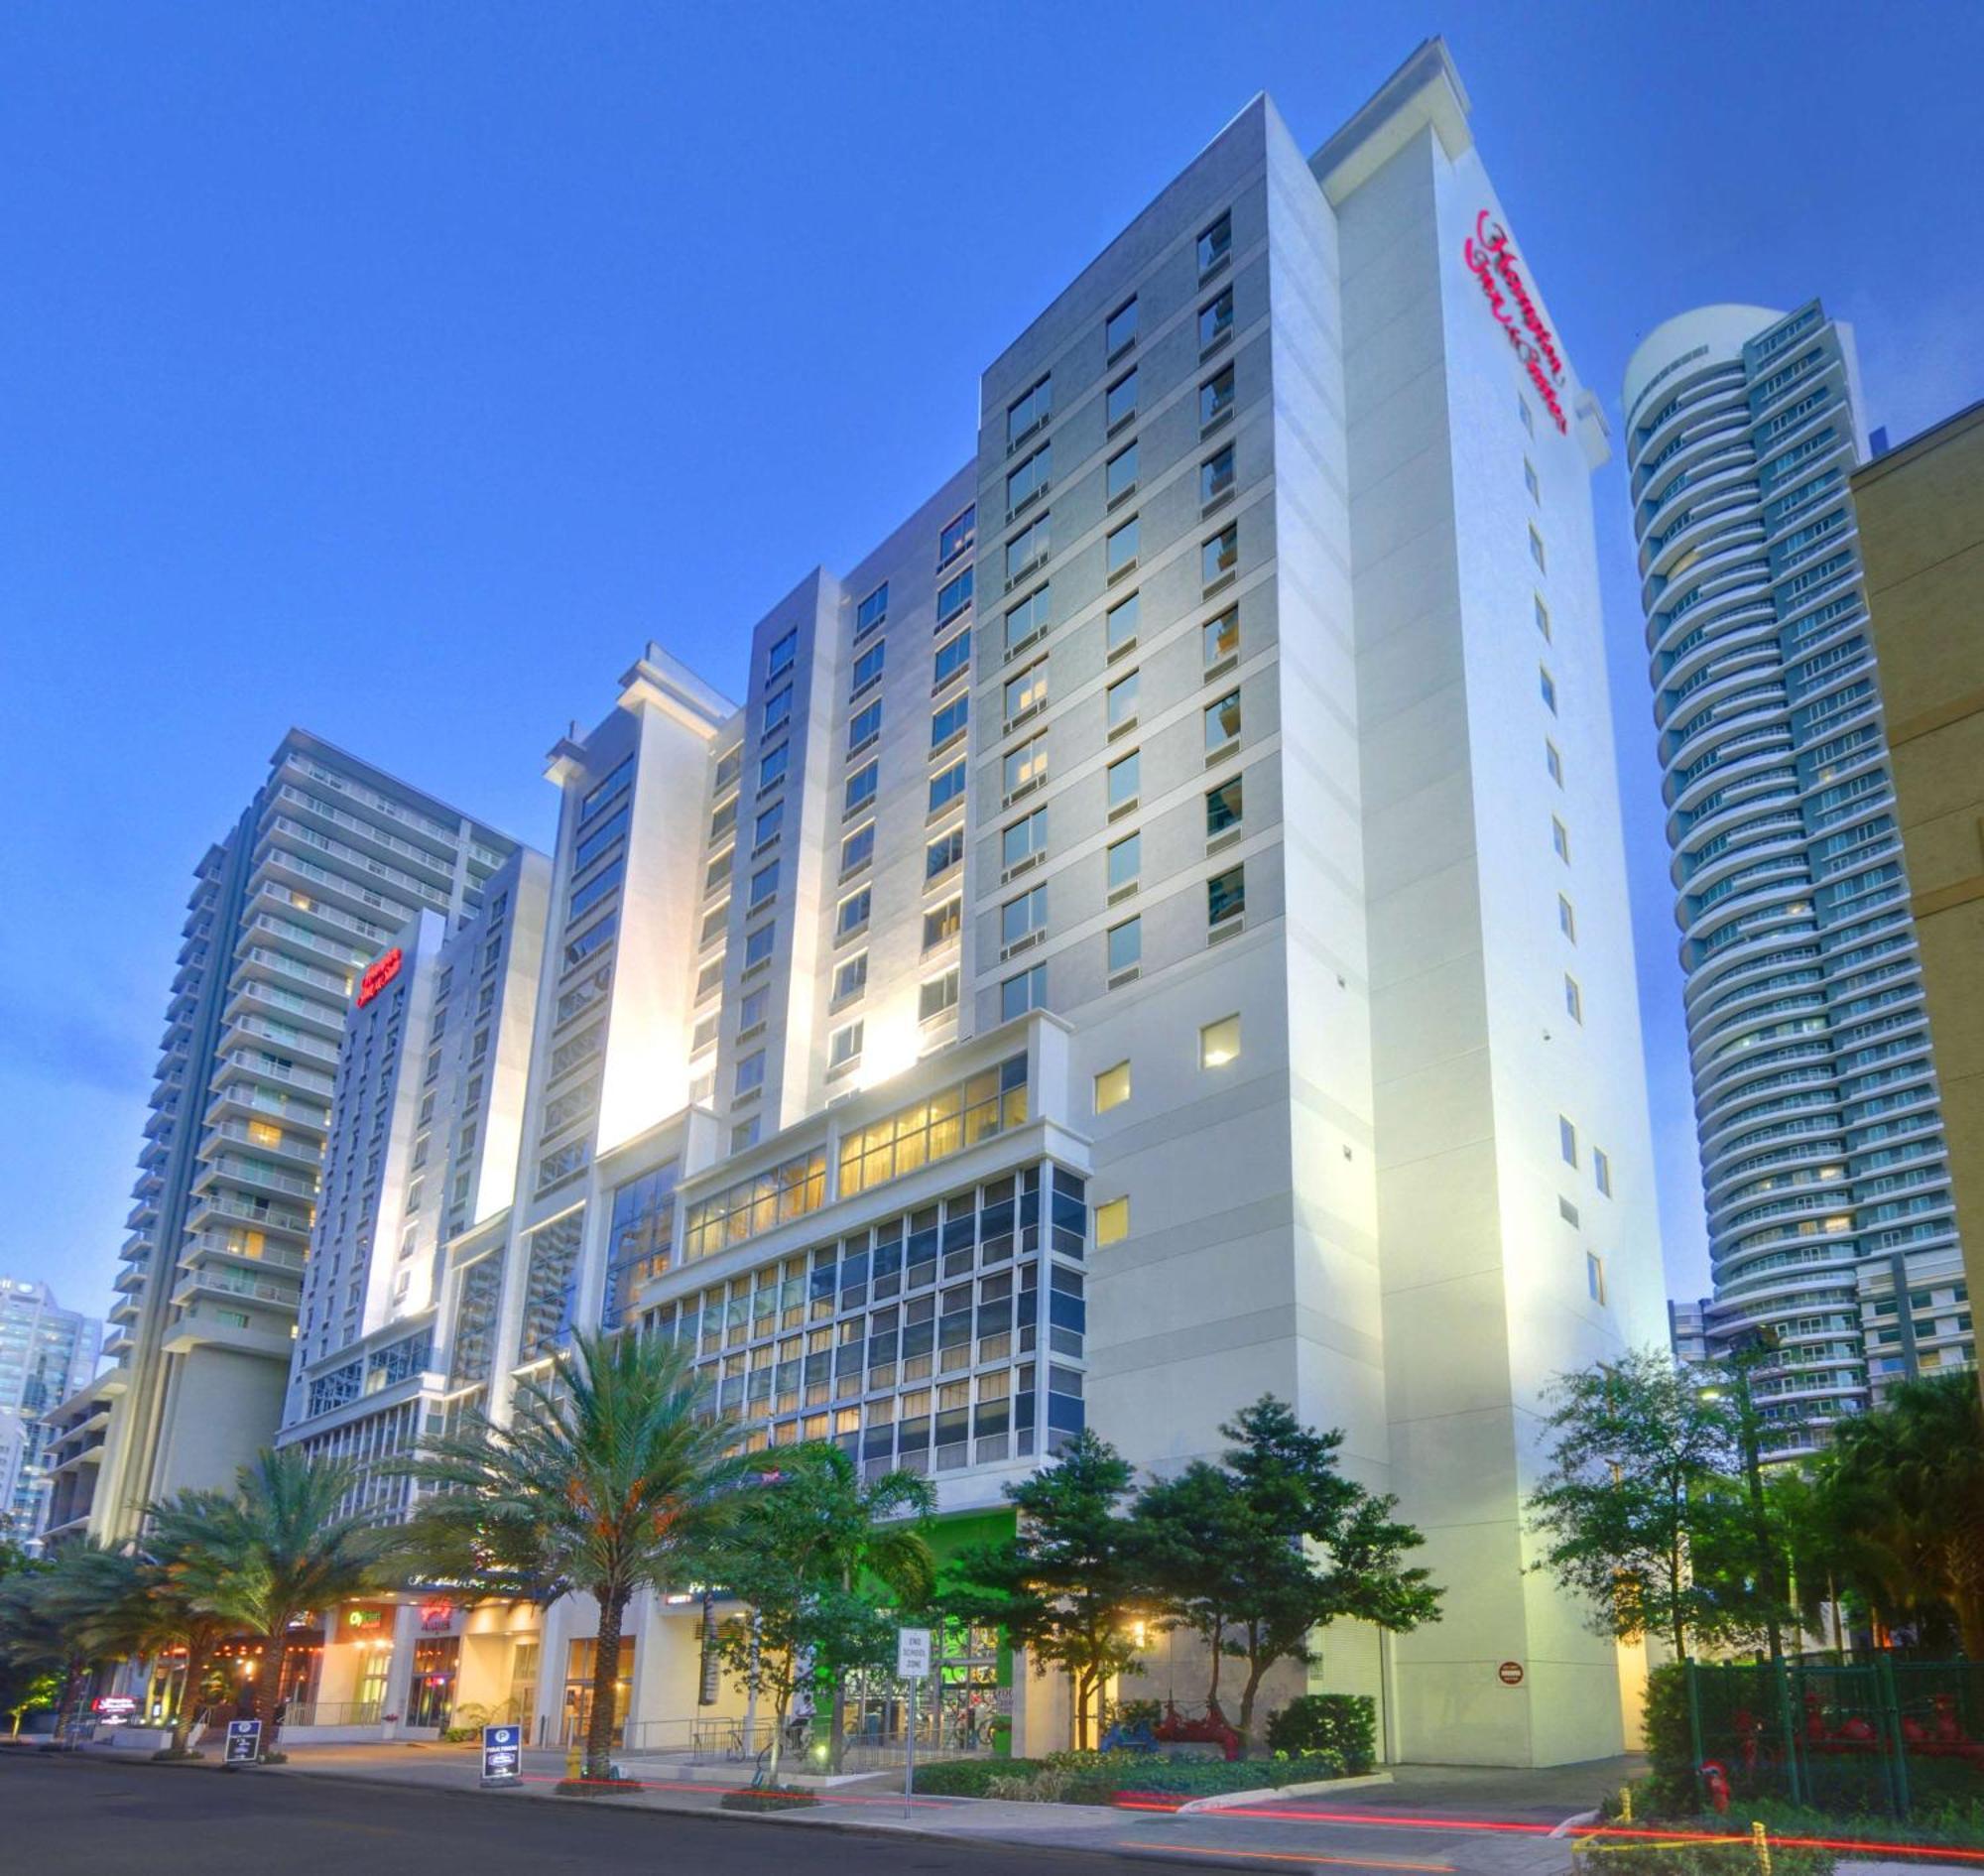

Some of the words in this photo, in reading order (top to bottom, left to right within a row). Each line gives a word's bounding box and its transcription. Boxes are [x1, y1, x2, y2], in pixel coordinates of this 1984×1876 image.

[1464, 237, 1513, 324] Inn
[1475, 207, 1566, 387] Hampton
[903, 1648, 926, 1657] SCHOOL
[906, 1659, 922, 1669] ZONE
